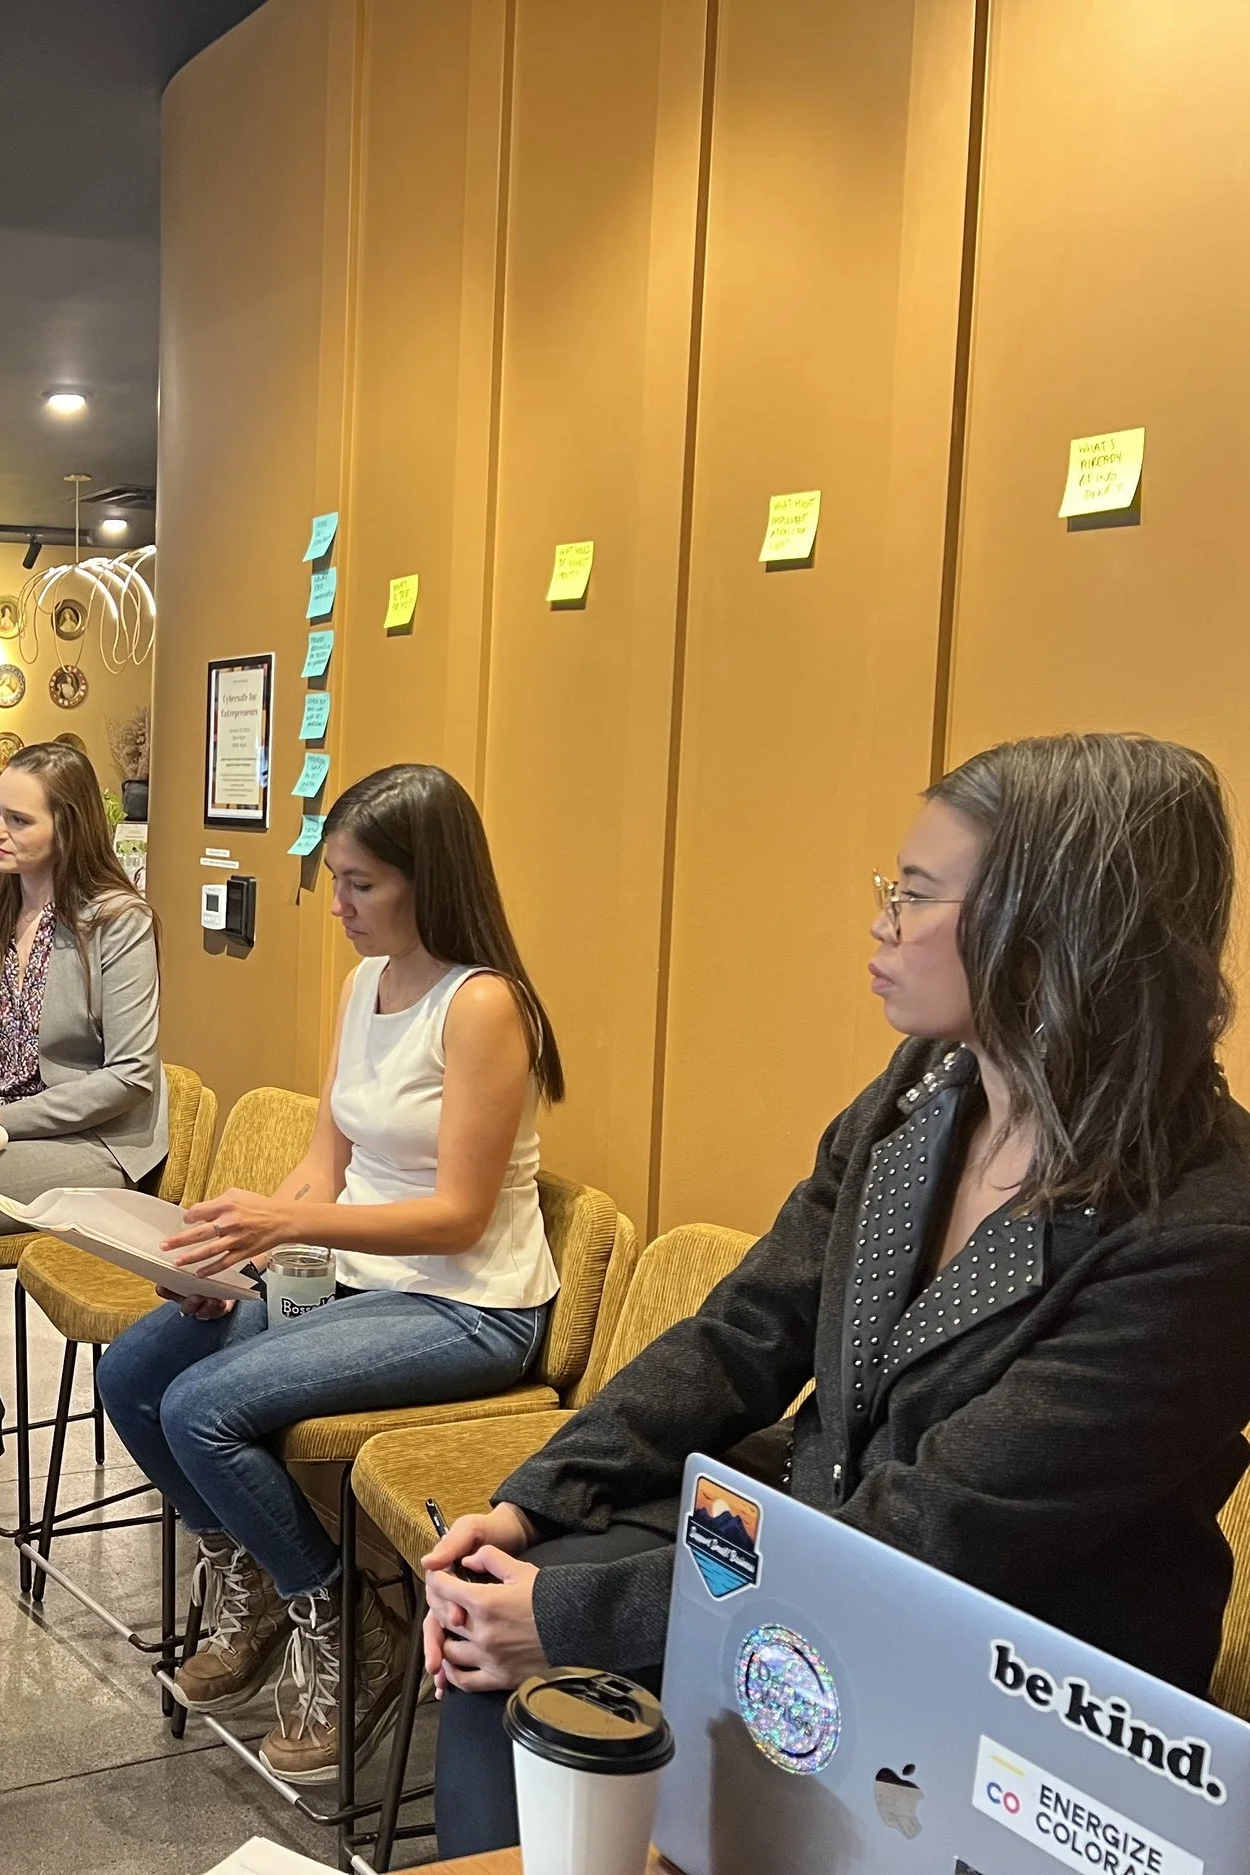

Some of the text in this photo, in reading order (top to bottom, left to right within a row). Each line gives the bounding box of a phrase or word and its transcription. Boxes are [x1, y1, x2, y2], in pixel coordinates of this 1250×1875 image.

[994, 1645, 1221, 1798] be kind.
[986, 1782, 1020, 1815] CO
[1039, 1784, 1163, 1874] ENERGIZE
